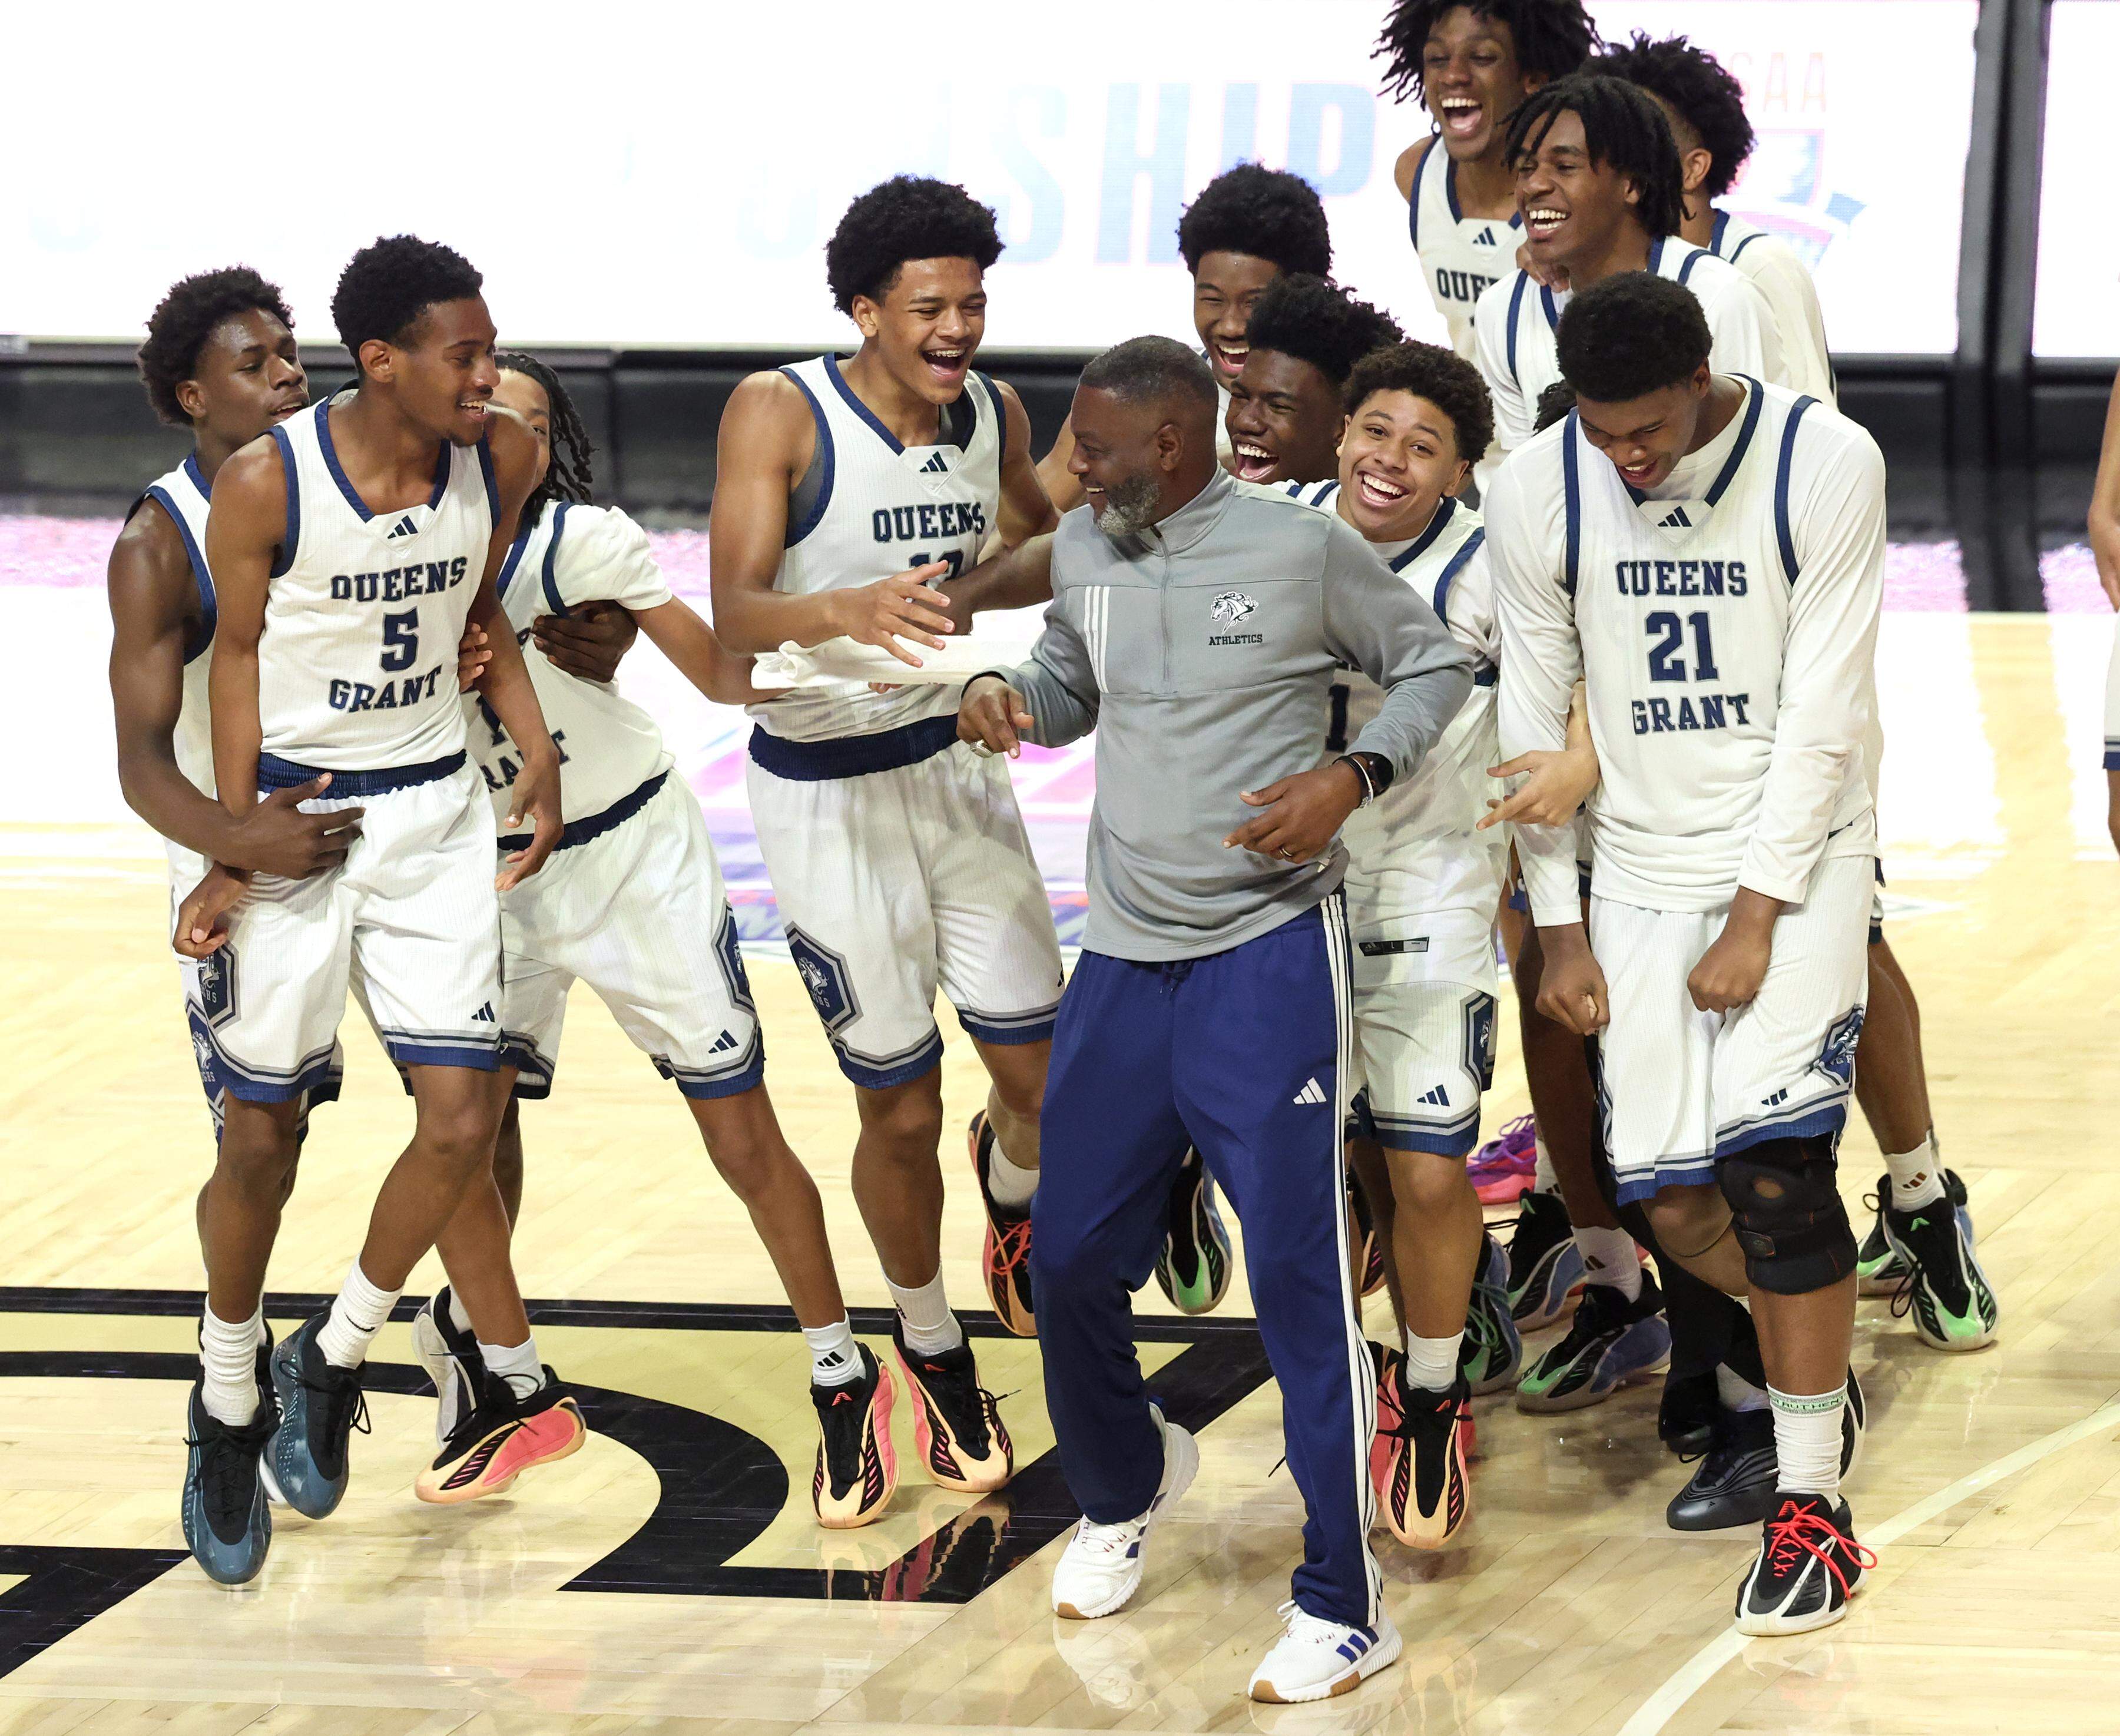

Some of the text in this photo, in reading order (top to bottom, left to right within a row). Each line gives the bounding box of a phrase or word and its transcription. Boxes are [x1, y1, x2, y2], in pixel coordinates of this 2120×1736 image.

[872, 501, 986, 544] QUEENS
[330, 555, 469, 602] QUEENS
[1615, 560, 1748, 598] QUEENS
[379, 606, 419, 673] 5
[1208, 634, 1263, 645] ATHLETICS
[1645, 610, 1720, 683] 21
[328, 663, 443, 713] GRANT
[1631, 693, 1751, 736] GRANT
